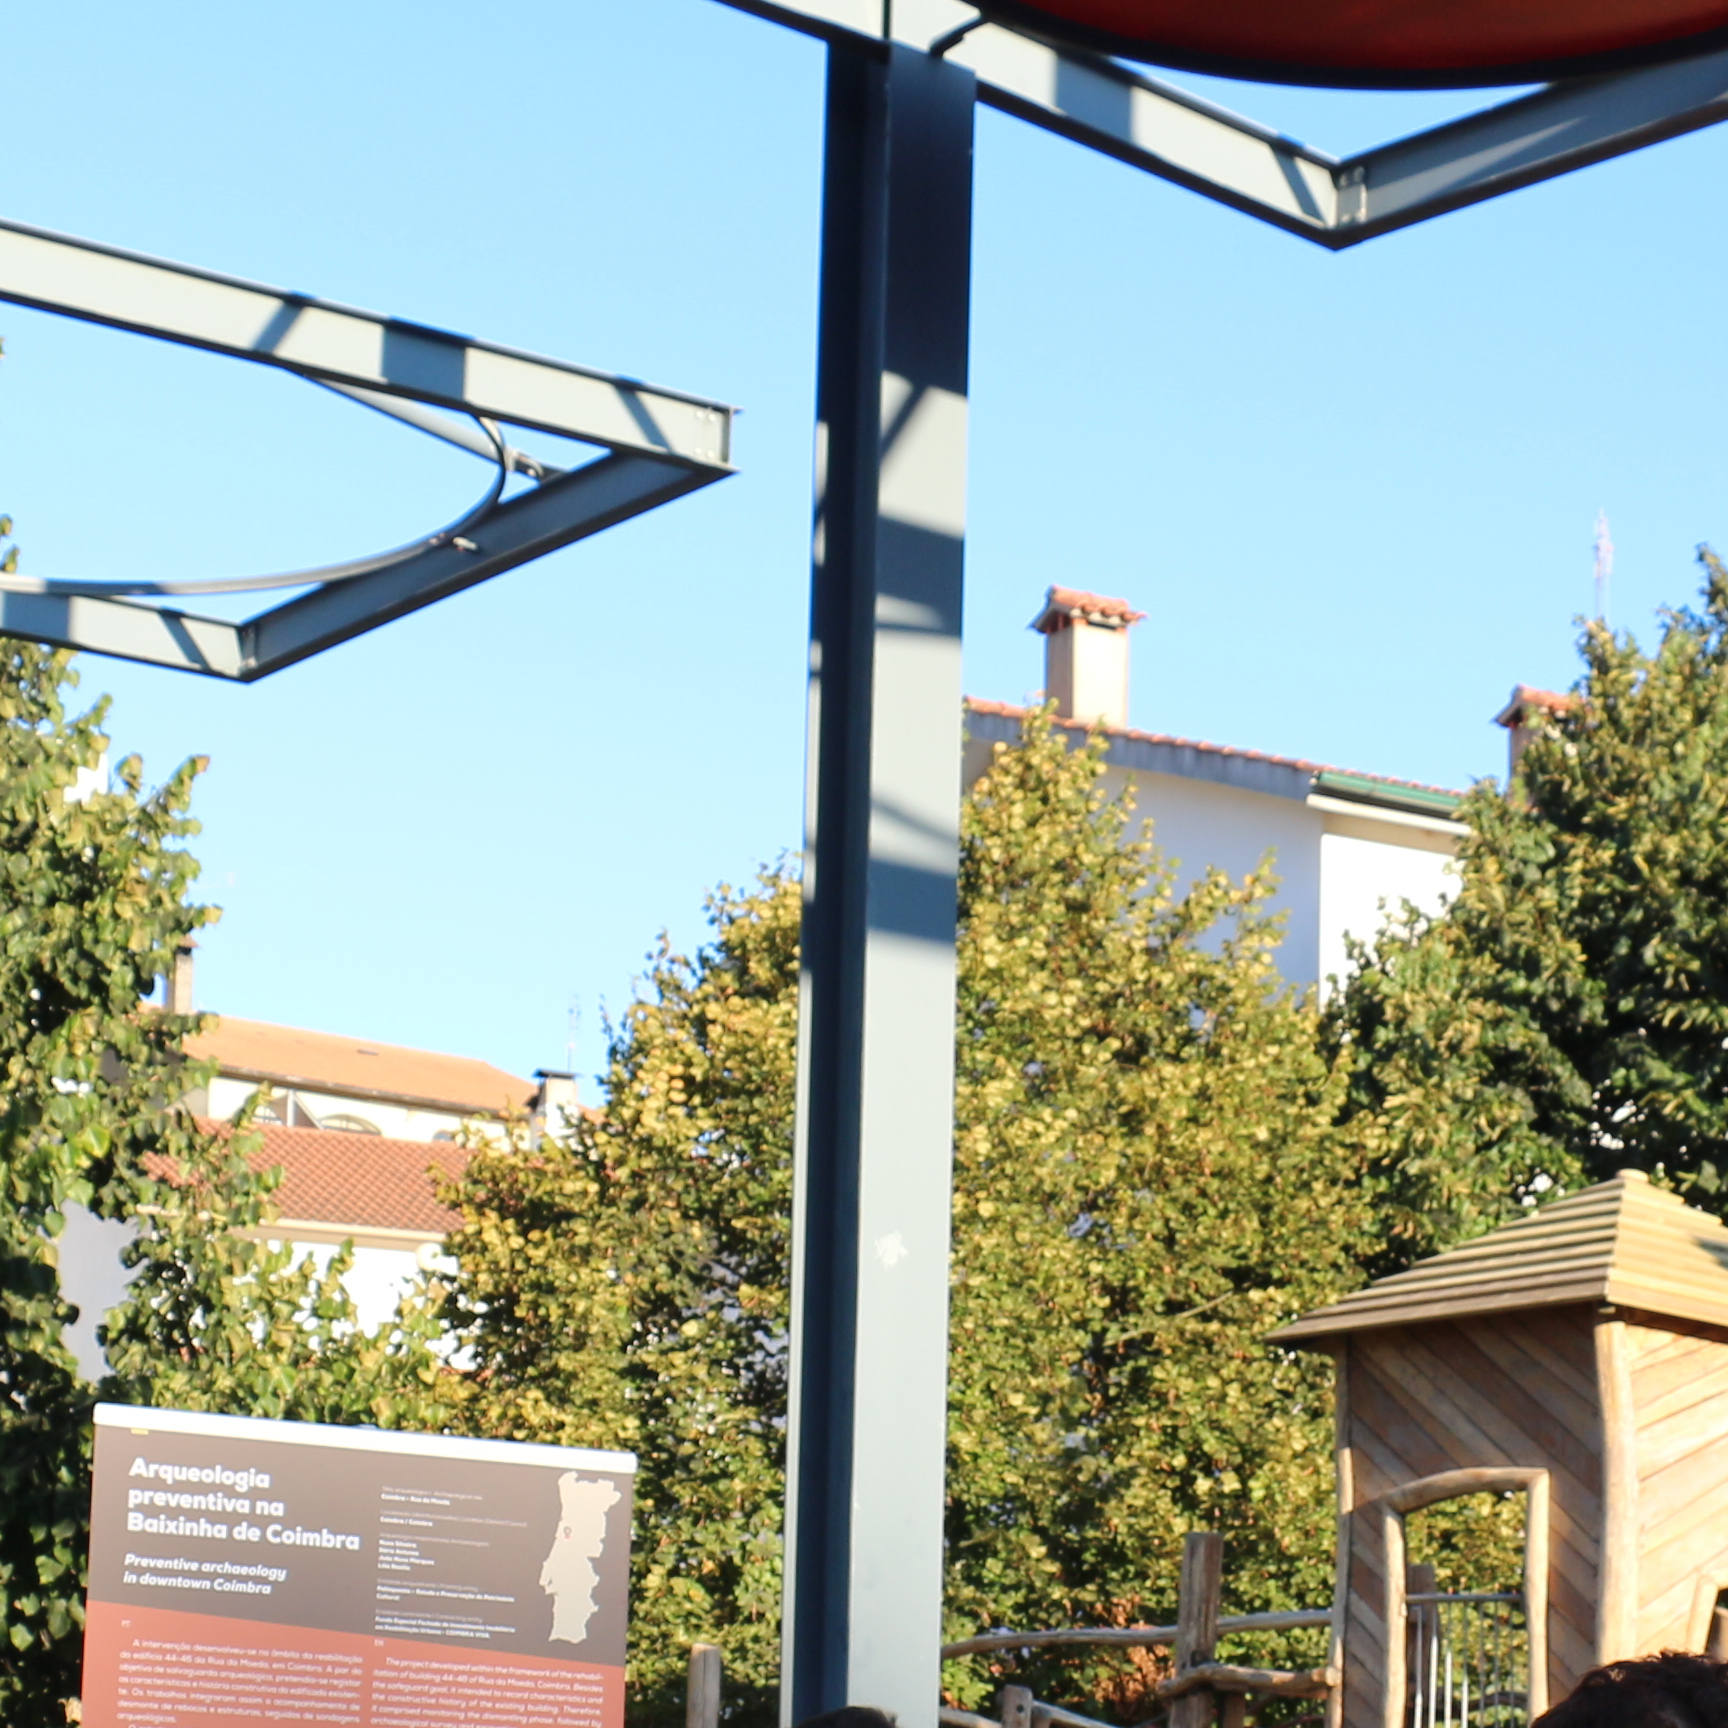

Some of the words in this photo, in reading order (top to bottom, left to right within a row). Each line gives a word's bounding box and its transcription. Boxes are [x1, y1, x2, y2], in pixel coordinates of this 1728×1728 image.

[129, 1458, 270, 1493] Arqueologia
[128, 1490, 250, 1514] preventiva
[256, 1501, 284, 1517] na
[128, 1512, 228, 1539] Baixinha
[233, 1522, 261, 1542] de
[266, 1524, 360, 1550] Coimbra
[124, 1554, 199, 1571] Preventive
[202, 1562, 287, 1582] archaeology
[124, 1571, 137, 1584] in
[140, 1573, 211, 1590] downtown
[214, 1578, 272, 1594] Coimbra
[133, 1639, 140, 1647] A
[208, 1656, 225, 1666] Rua
[326, 1665, 333, 1673] A
[386, 1658, 400, 1666] The
